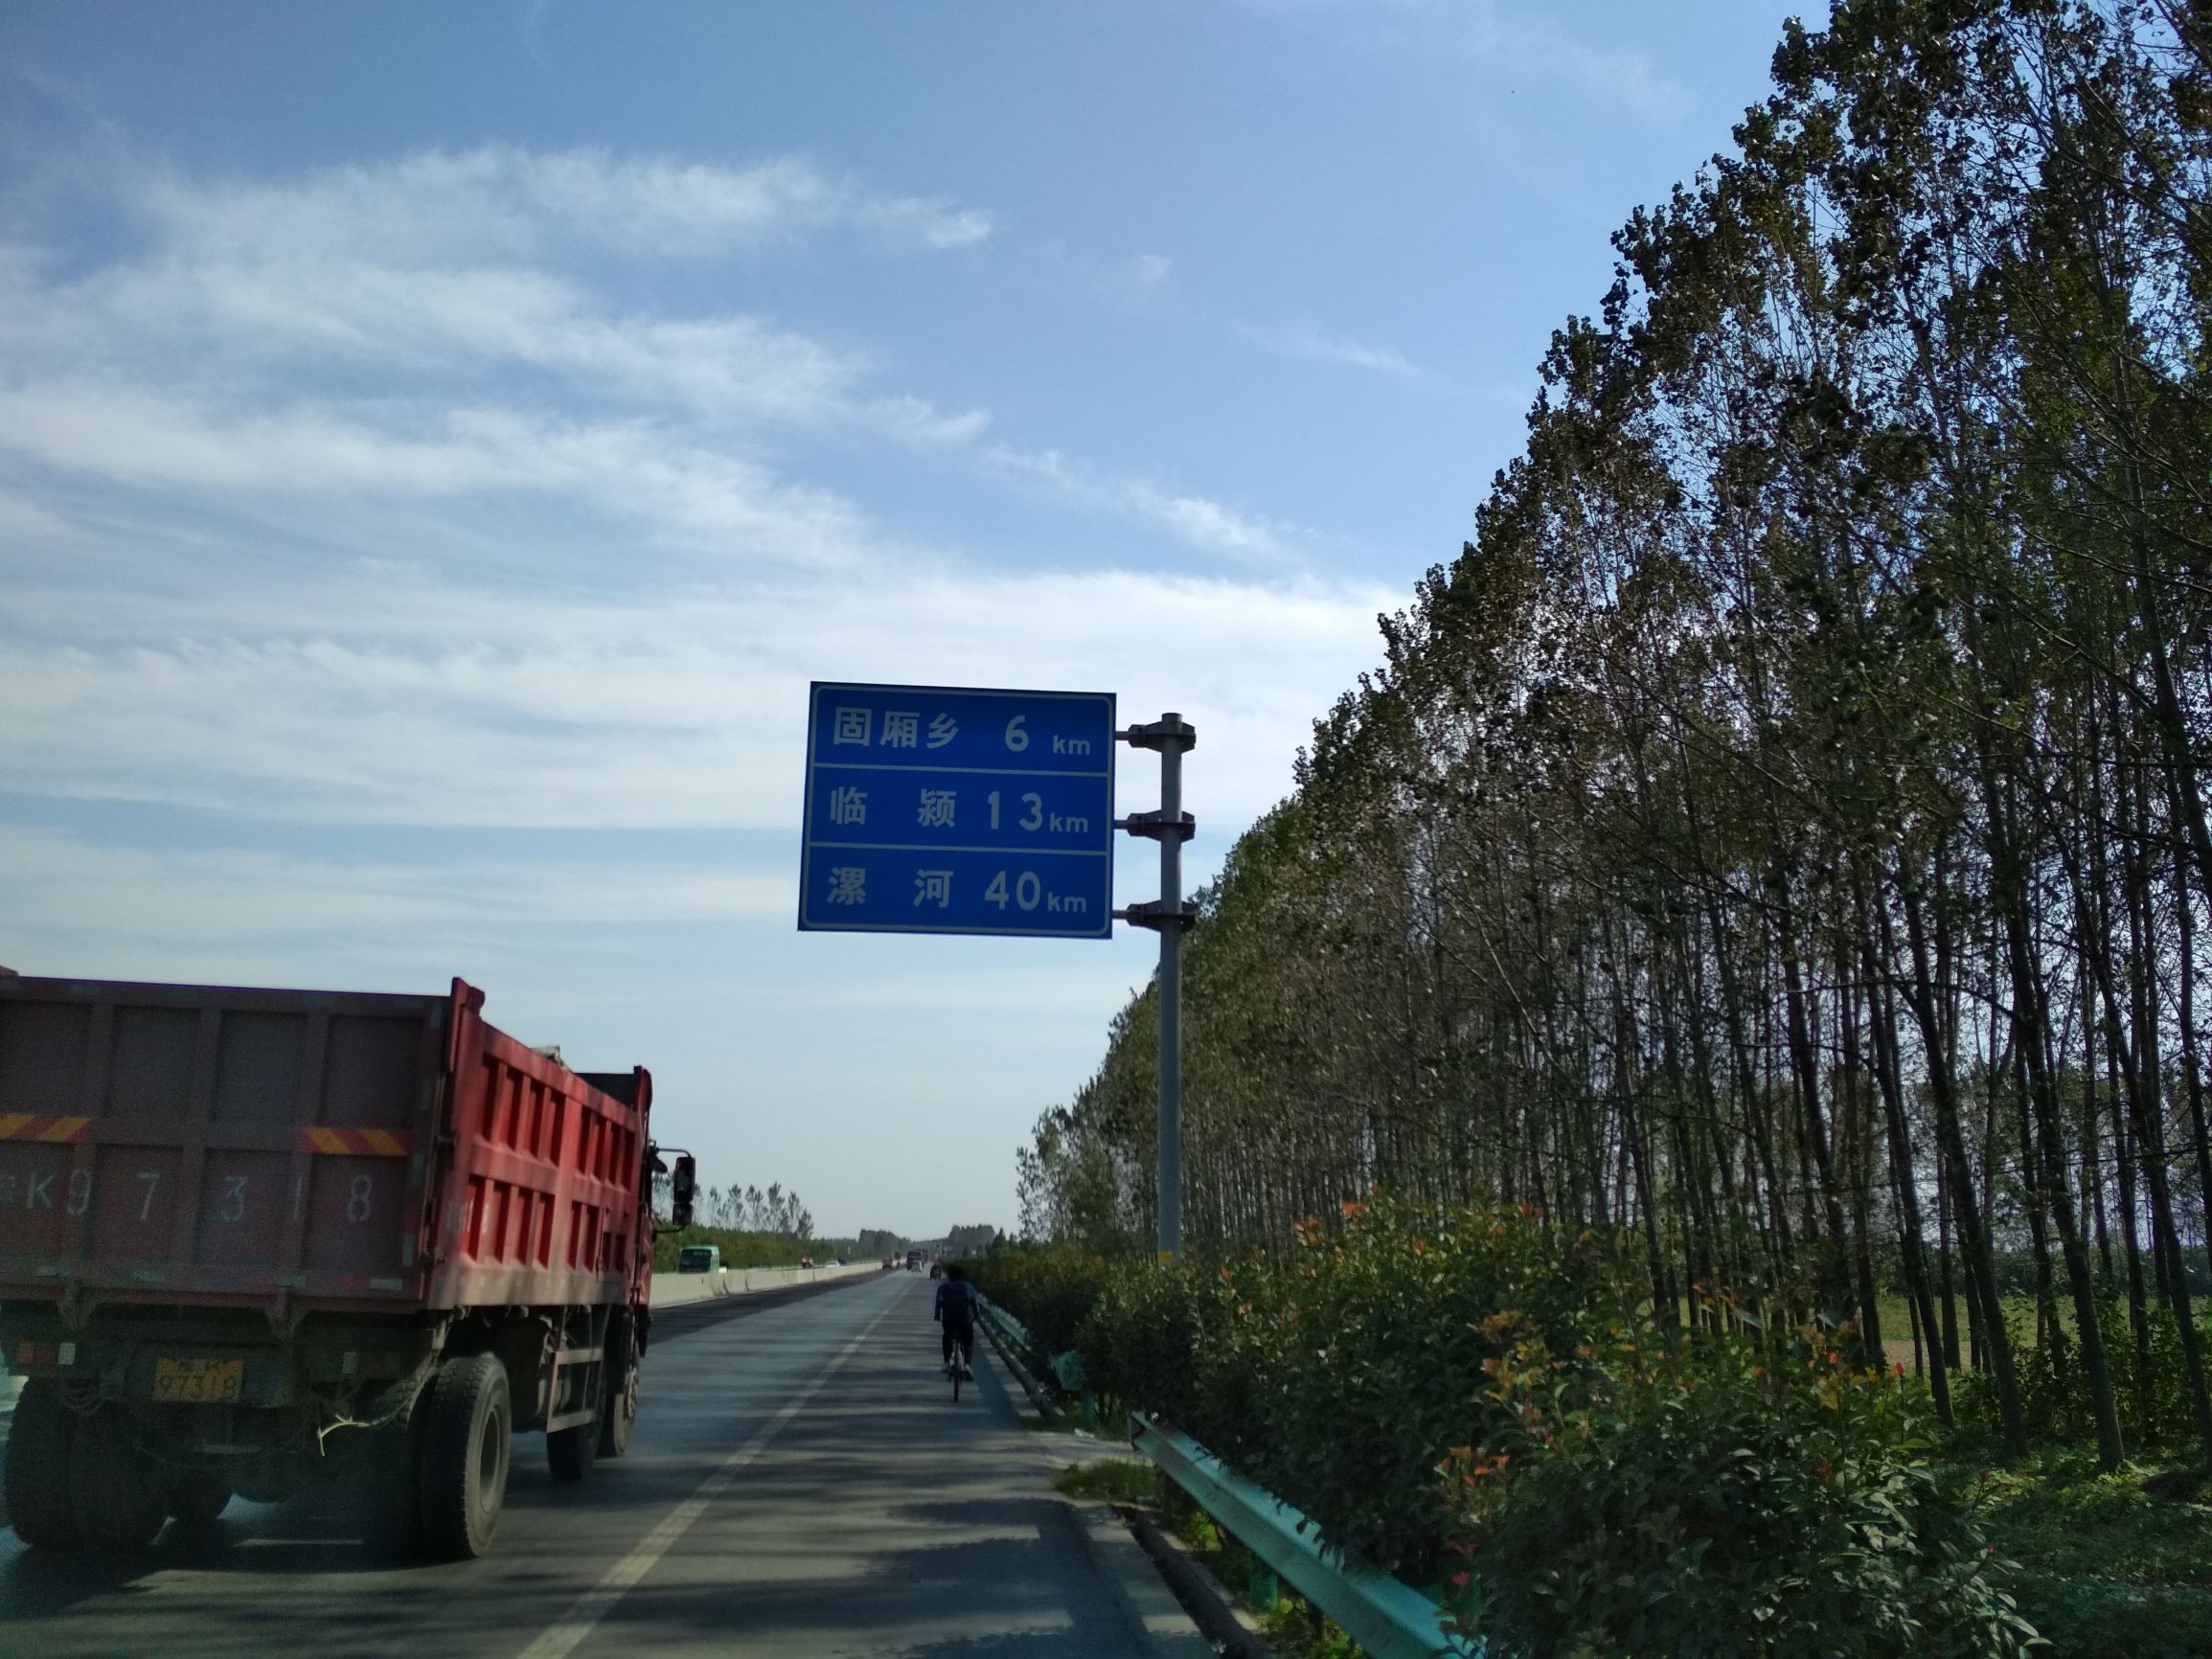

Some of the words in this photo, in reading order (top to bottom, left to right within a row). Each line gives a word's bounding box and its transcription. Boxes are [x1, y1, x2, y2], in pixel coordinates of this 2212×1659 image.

[832, 706, 960, 749] 固厢乡
[1004, 714, 1029, 752] 6
[1052, 734, 1091, 756] km
